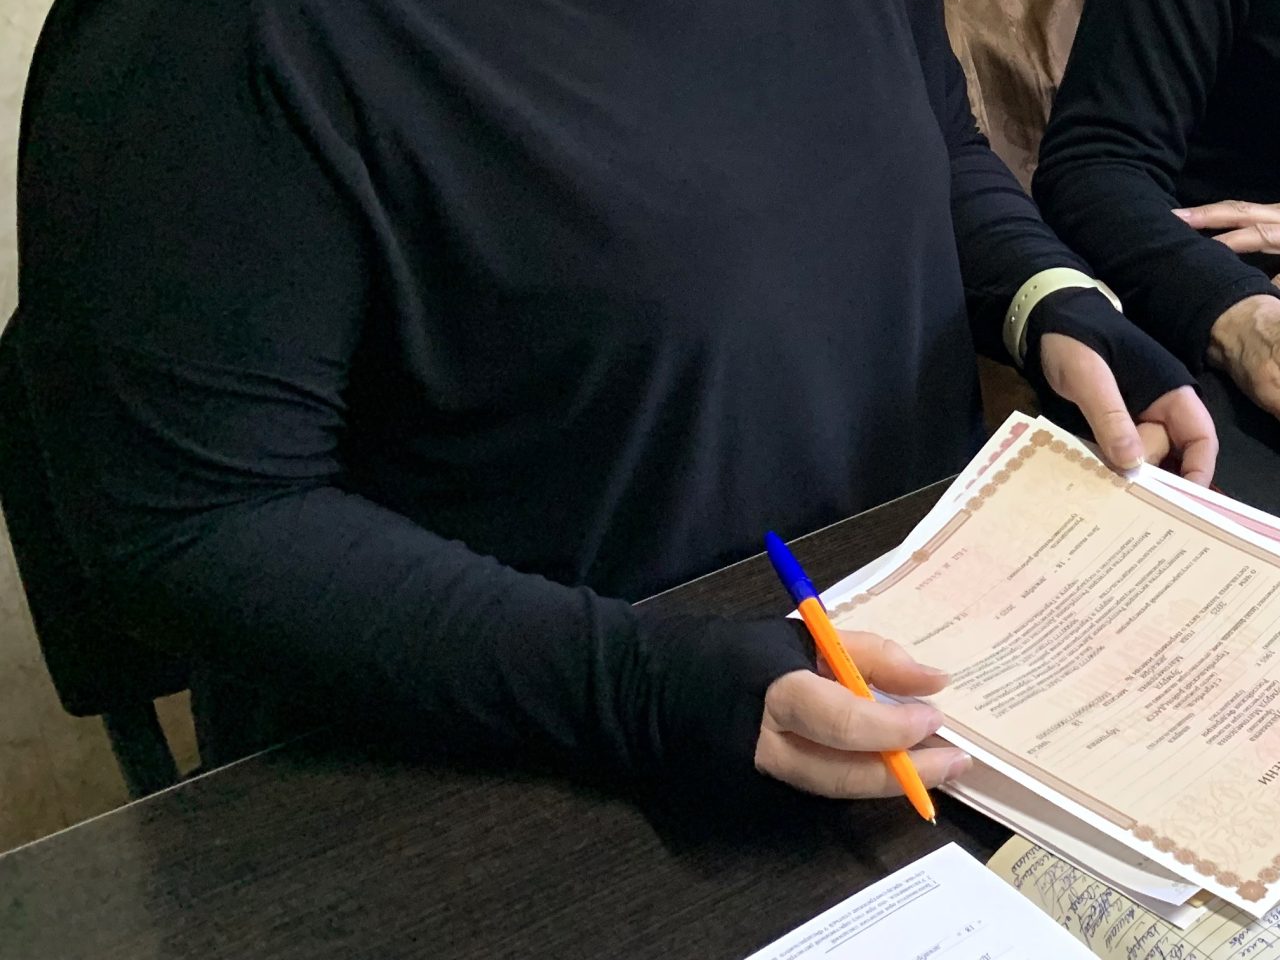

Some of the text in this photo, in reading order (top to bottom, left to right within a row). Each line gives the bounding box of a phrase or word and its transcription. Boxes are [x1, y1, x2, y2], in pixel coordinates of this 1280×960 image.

[1200, 677, 1269, 738] Российская Федерация
[1216, 707, 1262, 747] Магомедовна
